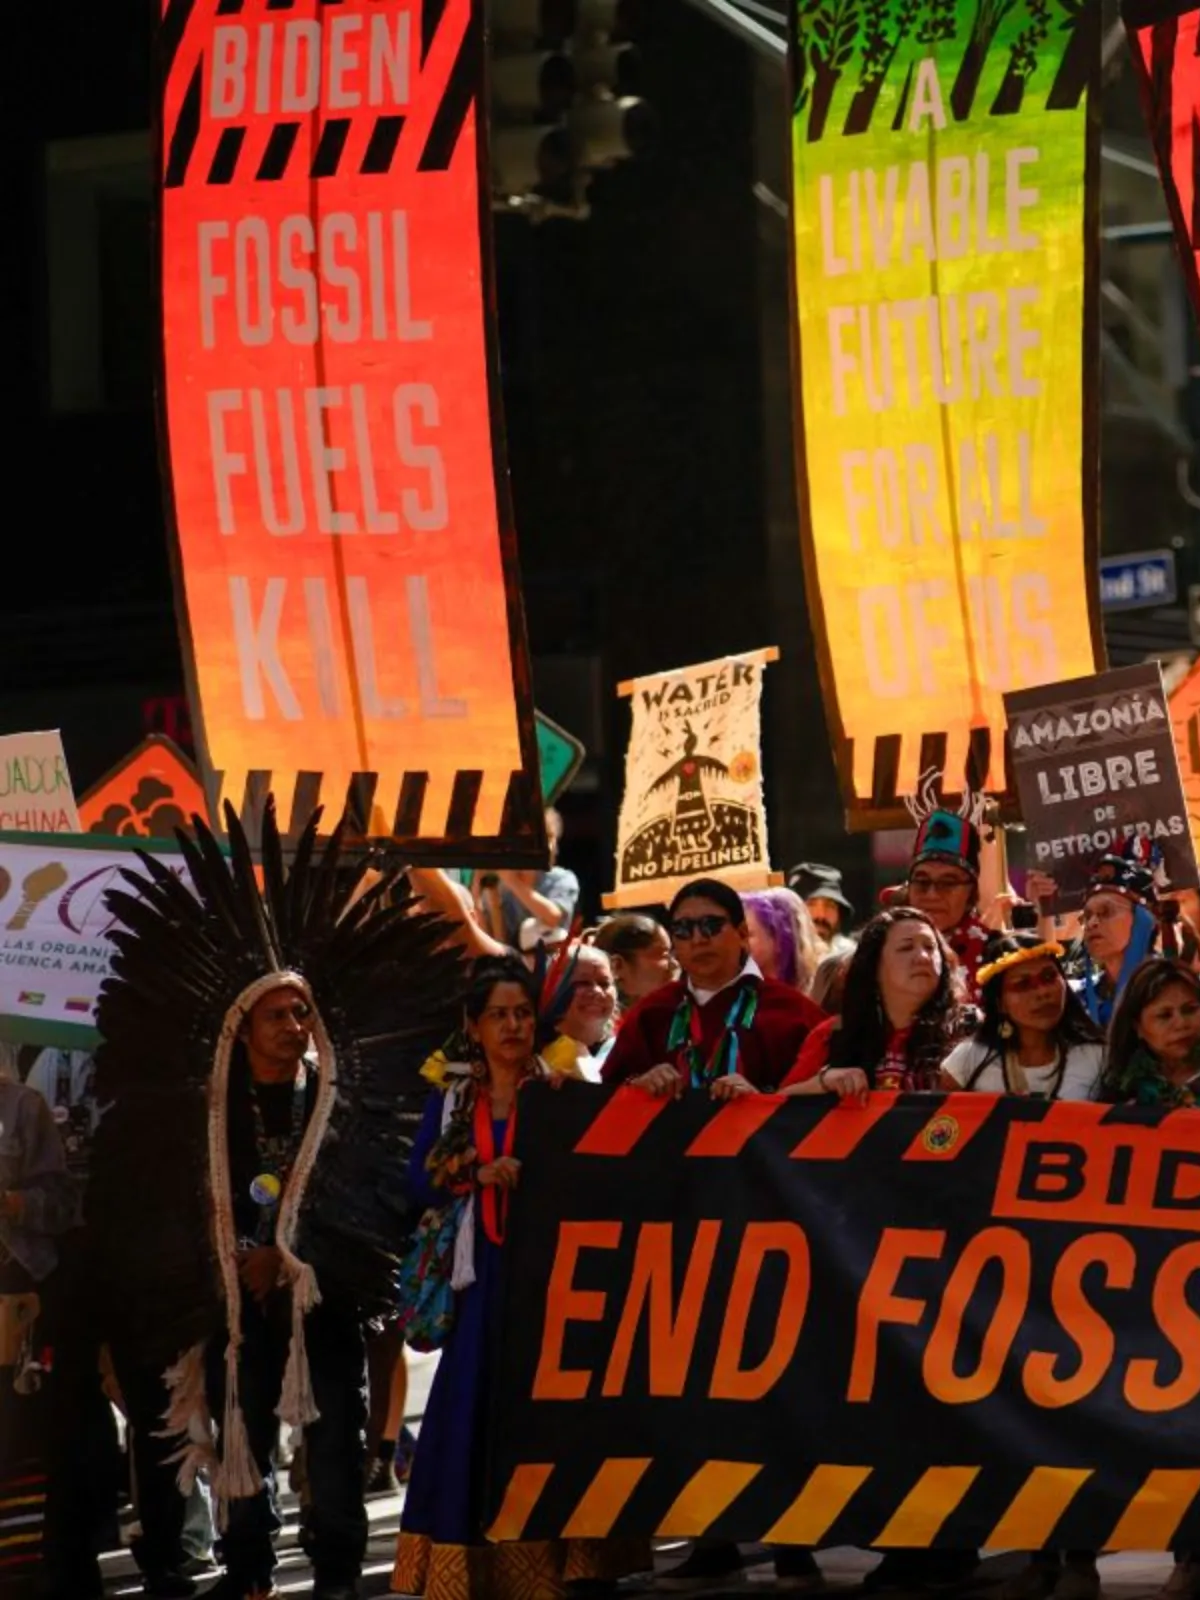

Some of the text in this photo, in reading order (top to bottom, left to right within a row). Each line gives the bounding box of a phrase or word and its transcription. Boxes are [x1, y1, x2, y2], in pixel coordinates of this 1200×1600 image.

[209, 11, 411, 119] BIDEN
[907, 57, 948, 133] A
[819, 146, 1040, 278] LIVABLE
[197, 210, 433, 350] FOSSIL
[827, 287, 1042, 418] FUTURE
[206, 382, 449, 537] FUELS
[839, 429, 1048, 555] FOR ALL
[228, 575, 468, 721] KILL
[642, 662, 754, 713] WATER
[858, 573, 1058, 699] OF US
[1014, 694, 1165, 749] AMAZONÍA
[1037, 749, 1161, 805] LIBRE
[629, 844, 757, 879] NO PIPELINES!
[1094, 805, 1116, 823] DE
[3, 939, 34, 952] LAS
[530, 1219, 811, 1400] END
